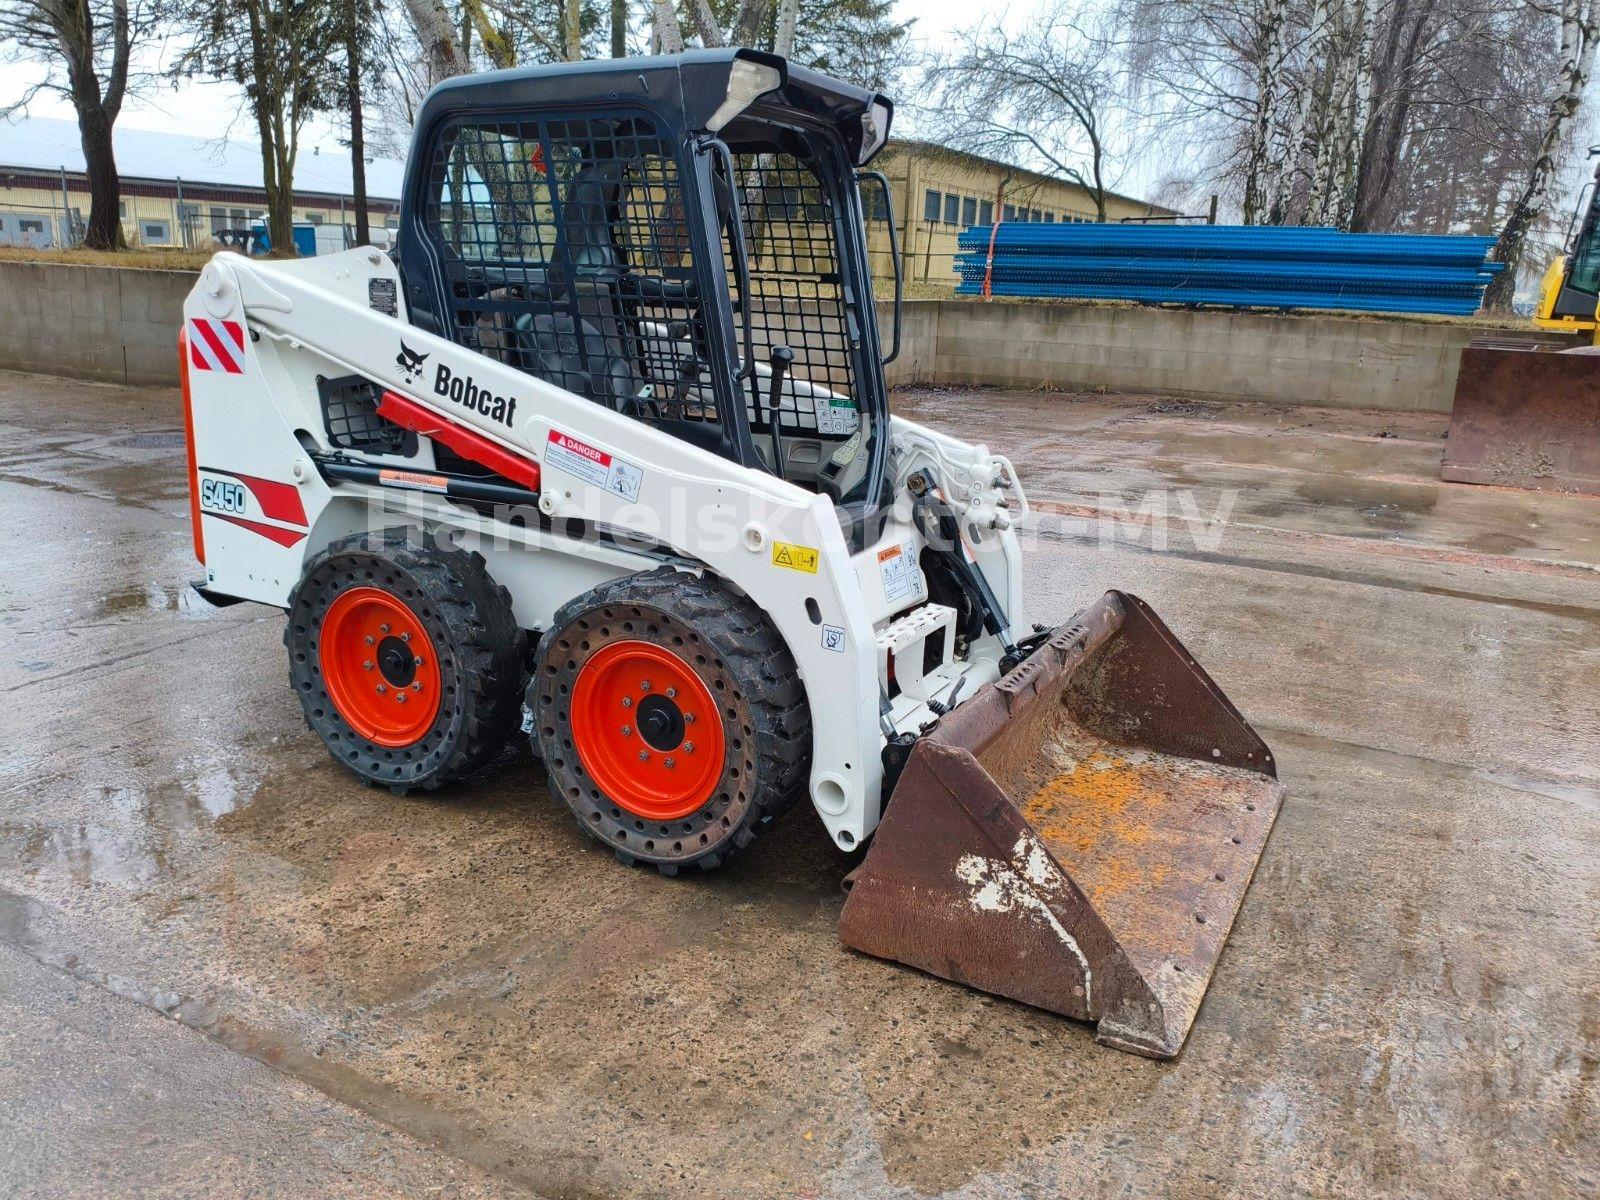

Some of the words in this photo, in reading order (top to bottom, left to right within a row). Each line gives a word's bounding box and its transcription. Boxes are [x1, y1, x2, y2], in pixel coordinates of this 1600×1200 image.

[434, 363, 516, 428] Bobcat
[567, 439, 602, 461] DANGER
[202, 478, 246, 514] S450
